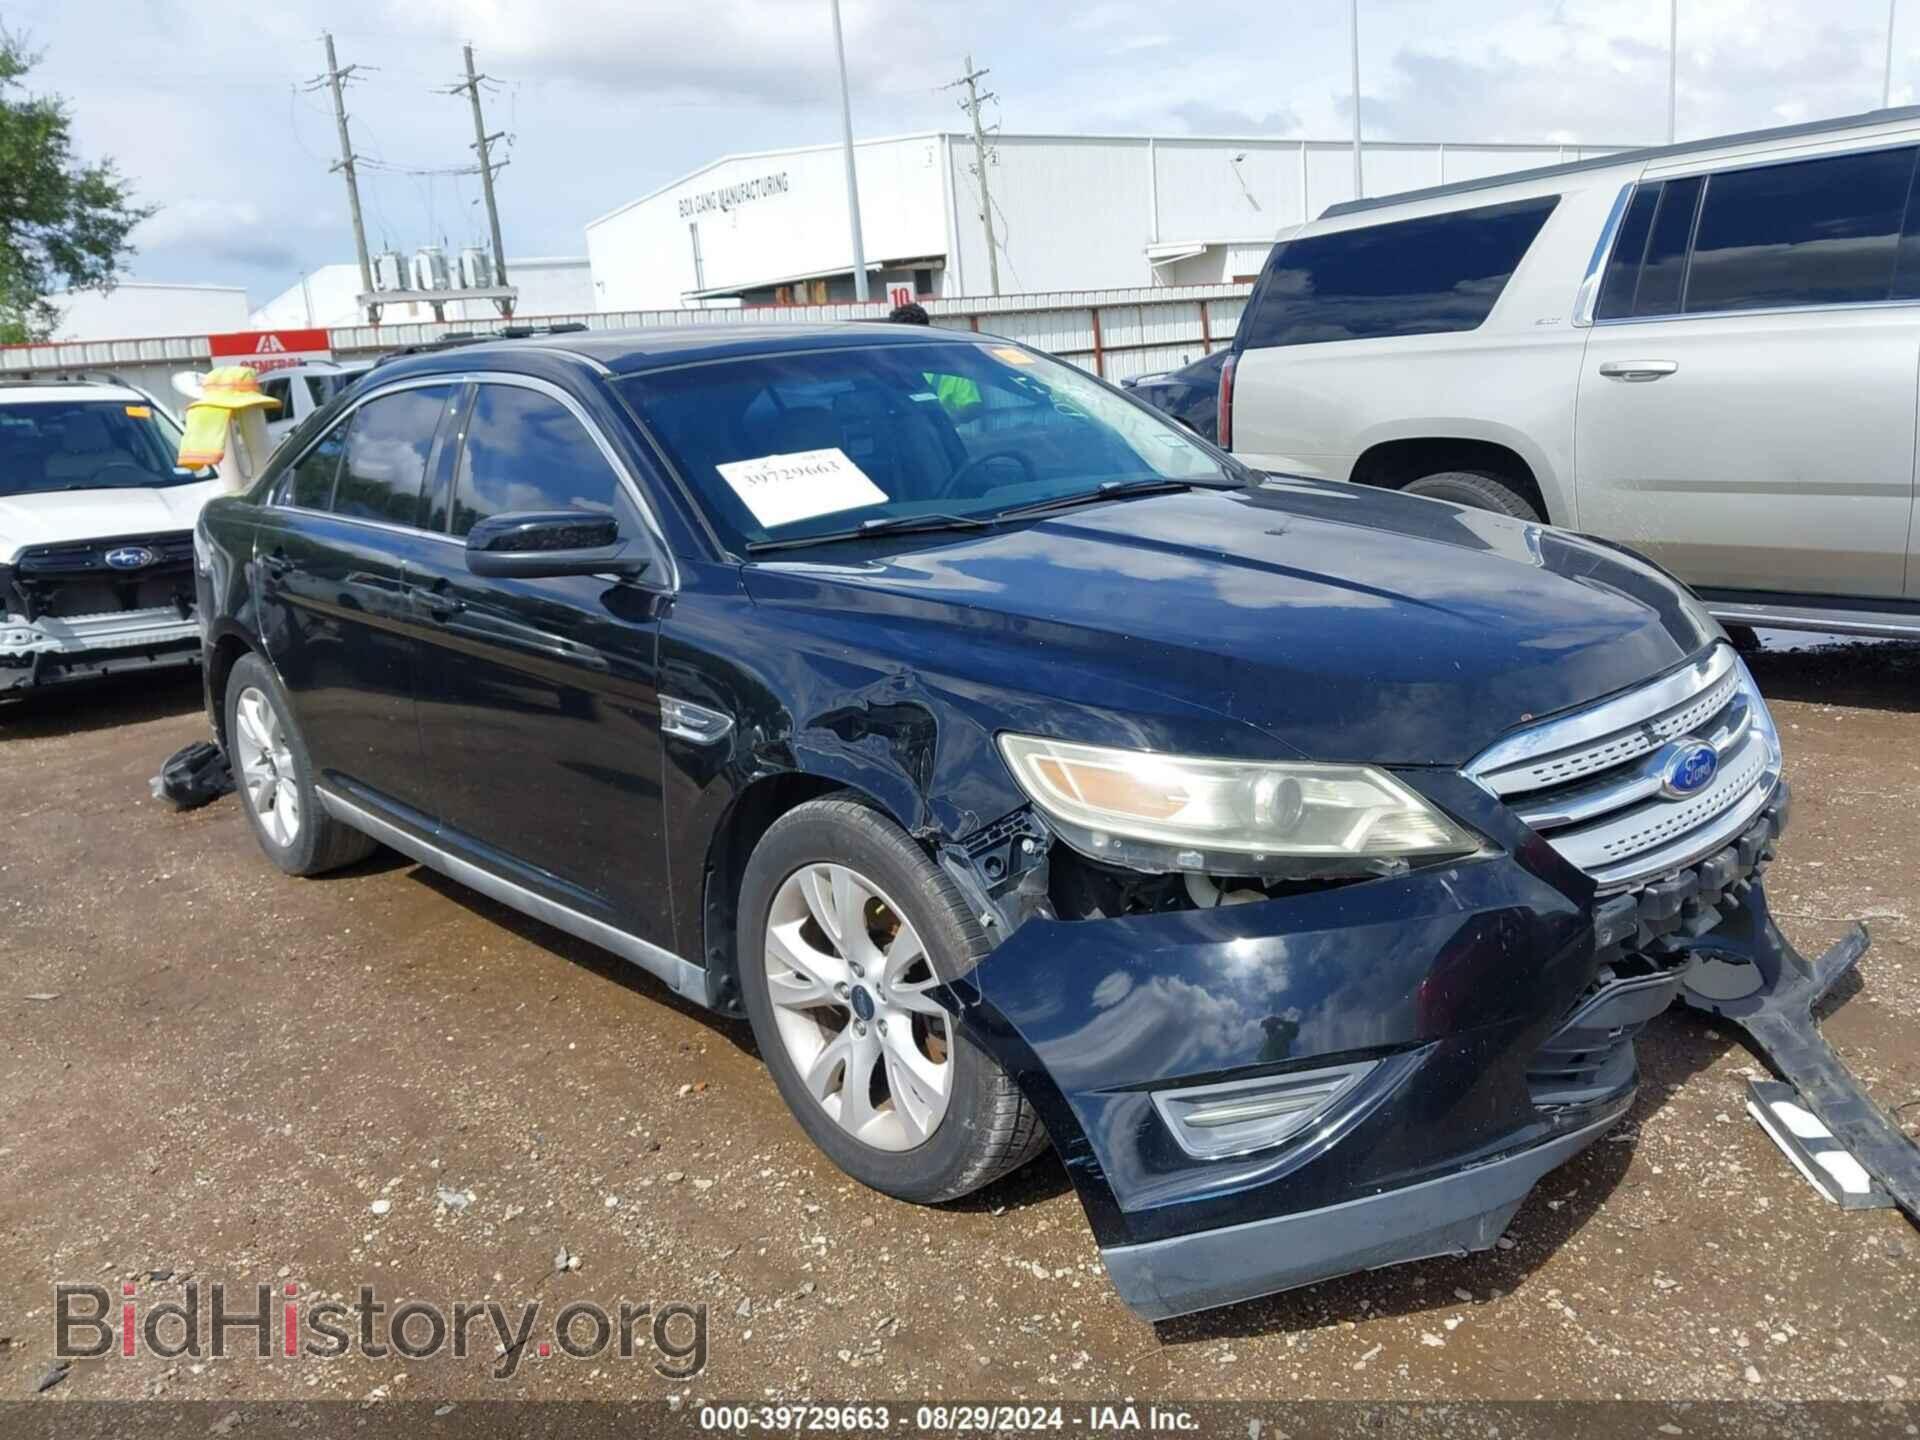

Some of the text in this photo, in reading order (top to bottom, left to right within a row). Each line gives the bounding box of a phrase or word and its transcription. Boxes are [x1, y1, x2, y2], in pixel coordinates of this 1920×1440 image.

[679, 198, 695, 217] BOX
[719, 171, 788, 204] MANUFACTURING
[891, 287, 910, 306] 10
[744, 461, 841, 485] 39729663
[1685, 752, 1711, 785] Ford
